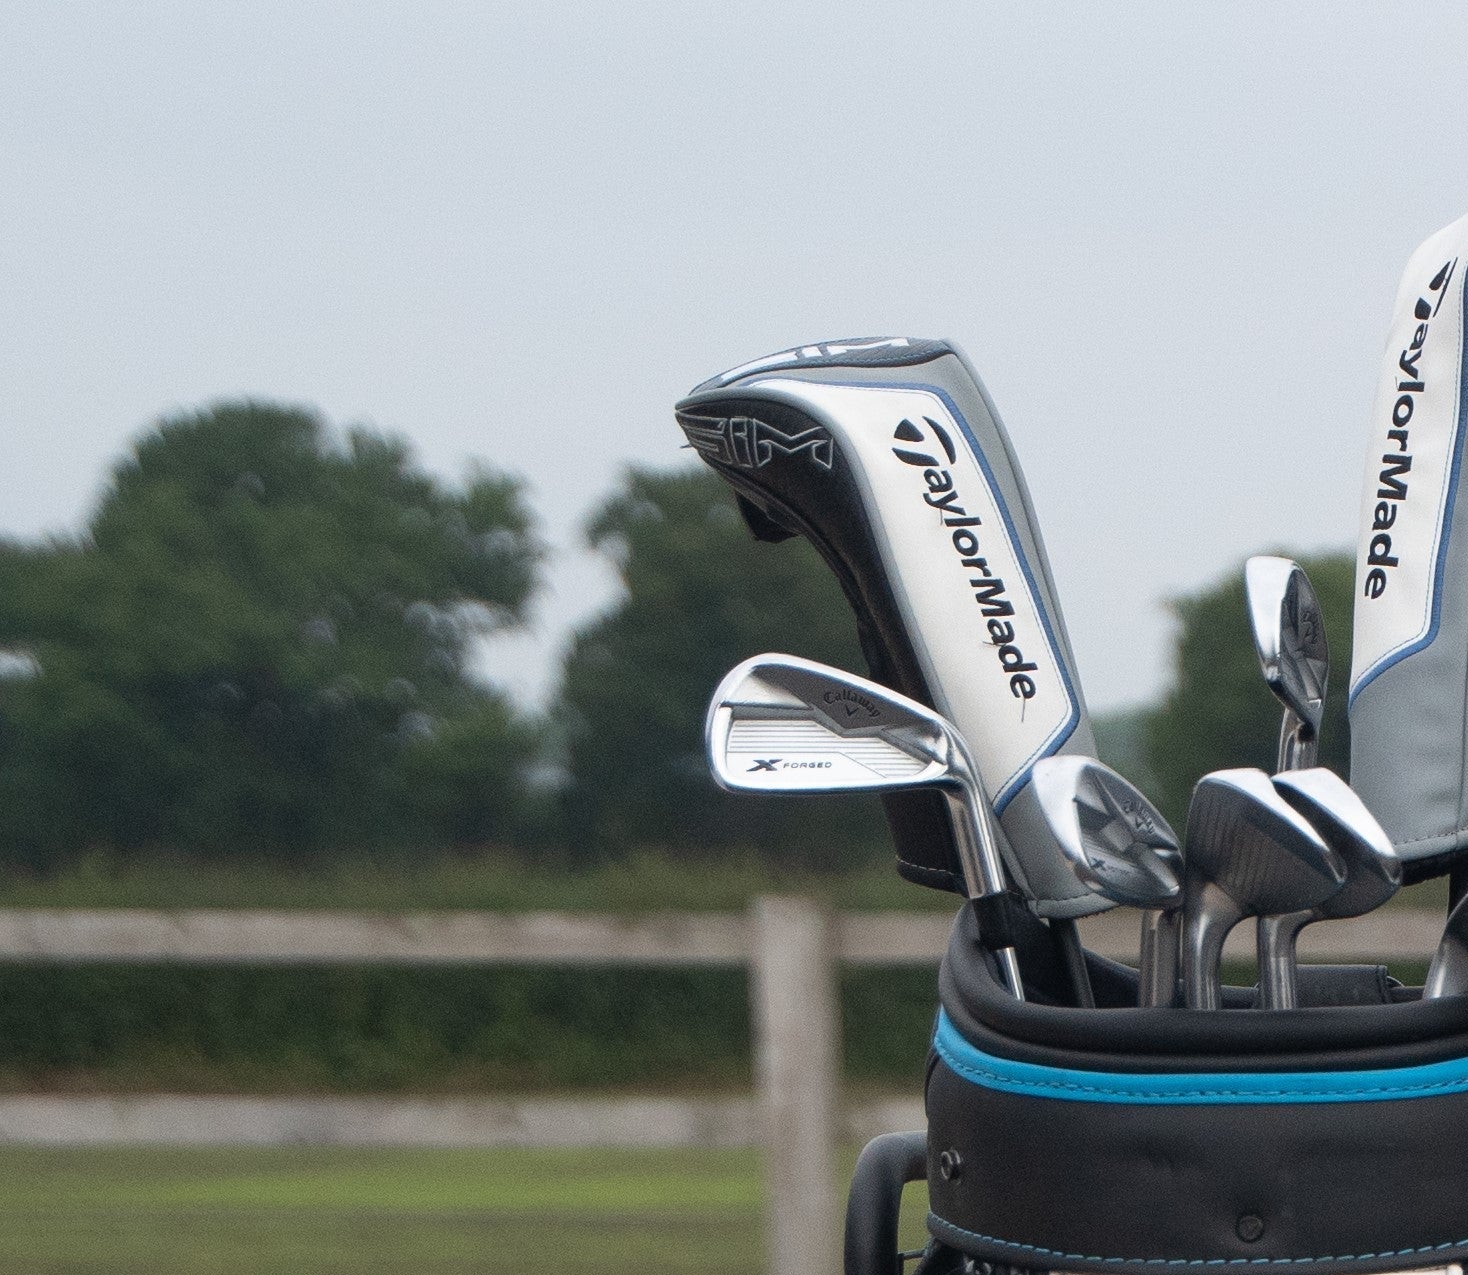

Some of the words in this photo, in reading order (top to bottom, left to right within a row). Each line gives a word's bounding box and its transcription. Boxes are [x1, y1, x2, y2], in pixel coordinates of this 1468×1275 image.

[1364, 257, 1458, 600] TaylorMade
[891, 415, 1038, 700] TaylorMade
[783, 761, 833, 769] FORGED
[823, 688, 881, 719] Callaway
